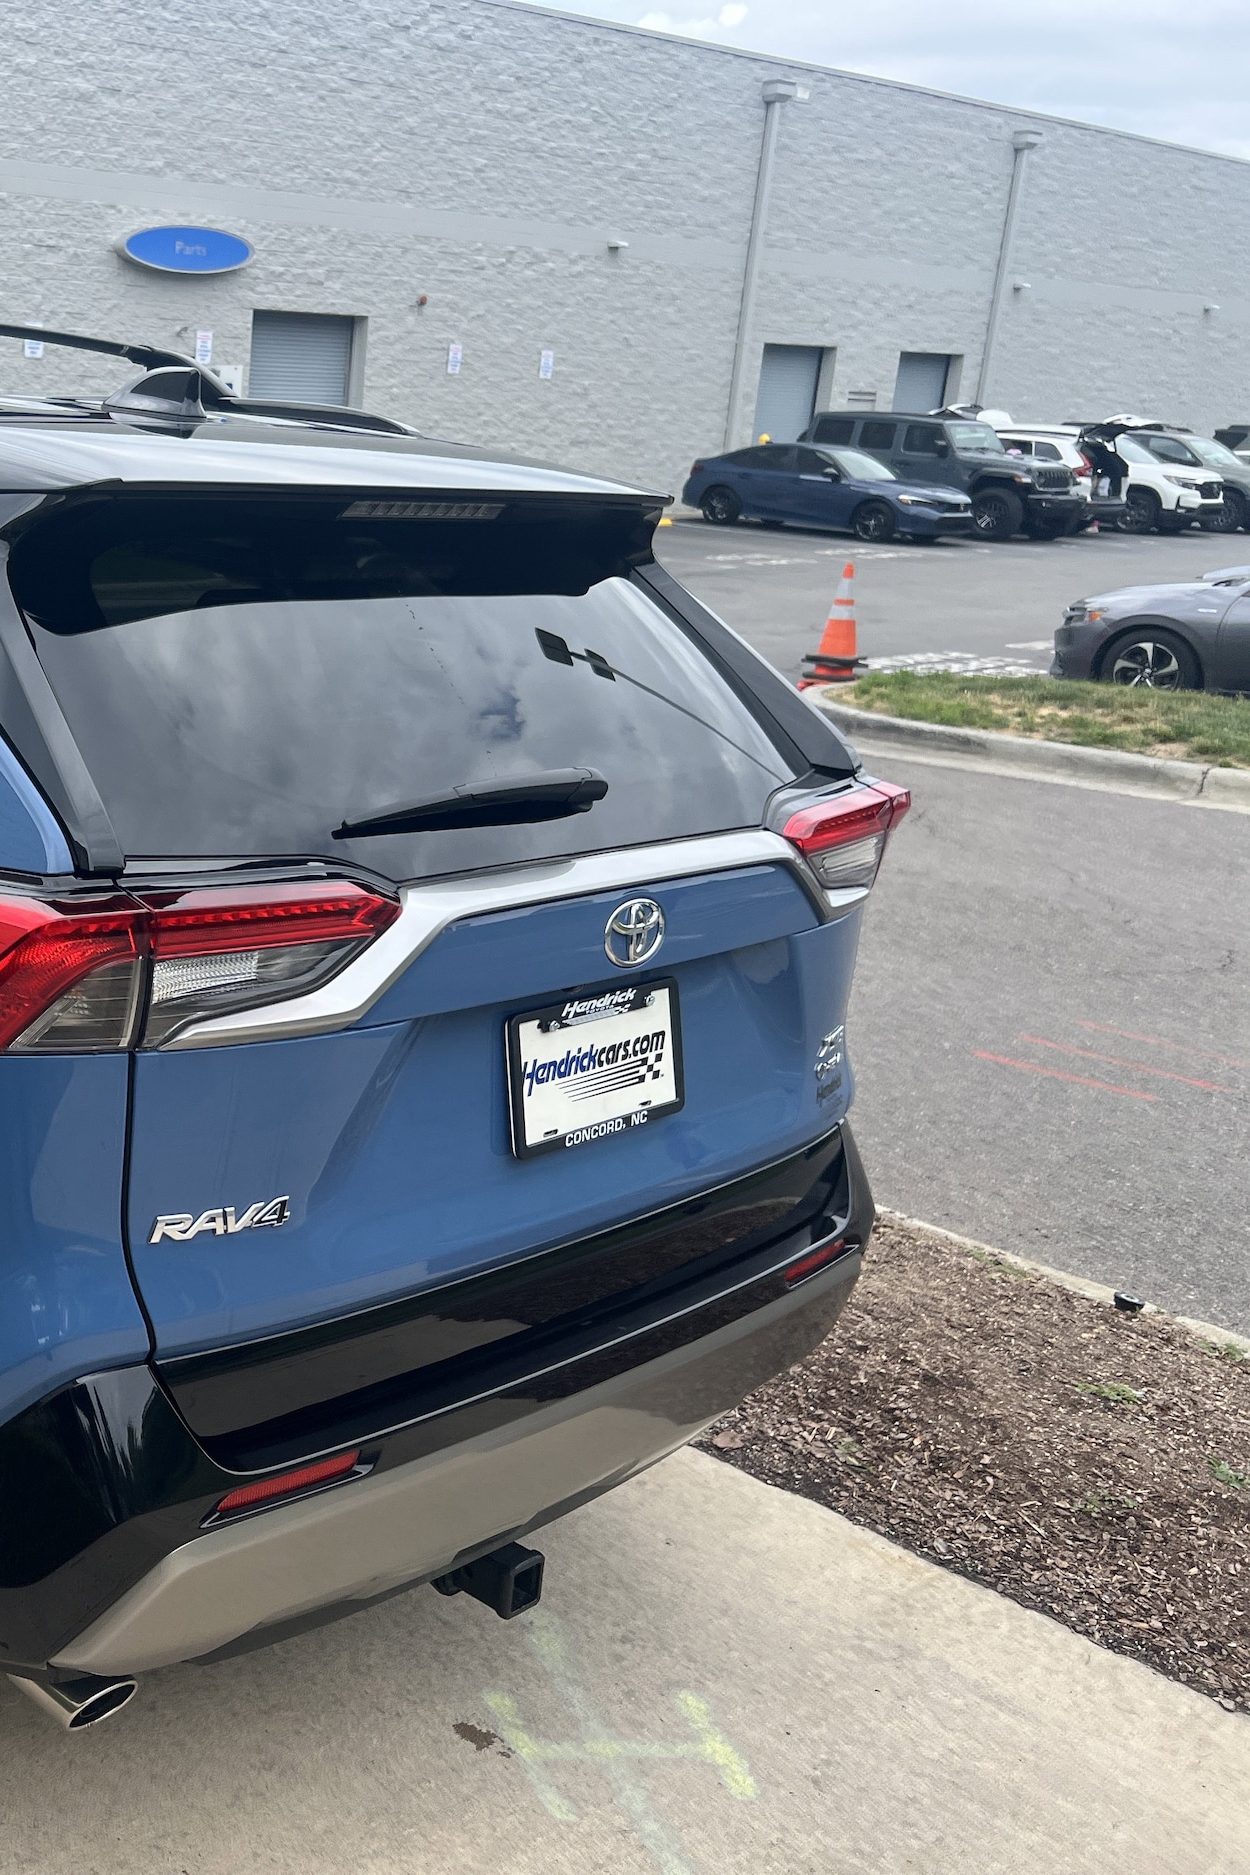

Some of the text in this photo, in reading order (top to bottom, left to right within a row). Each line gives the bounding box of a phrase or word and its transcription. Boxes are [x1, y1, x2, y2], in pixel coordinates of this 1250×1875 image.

[174, 240, 207, 256] Parts
[561, 987, 637, 1018] Hendrick
[523, 1030, 666, 1097] Hendrickcars.com
[564, 1110, 649, 1148] CONCORD, NC
[148, 1195, 291, 1244] RAV4
